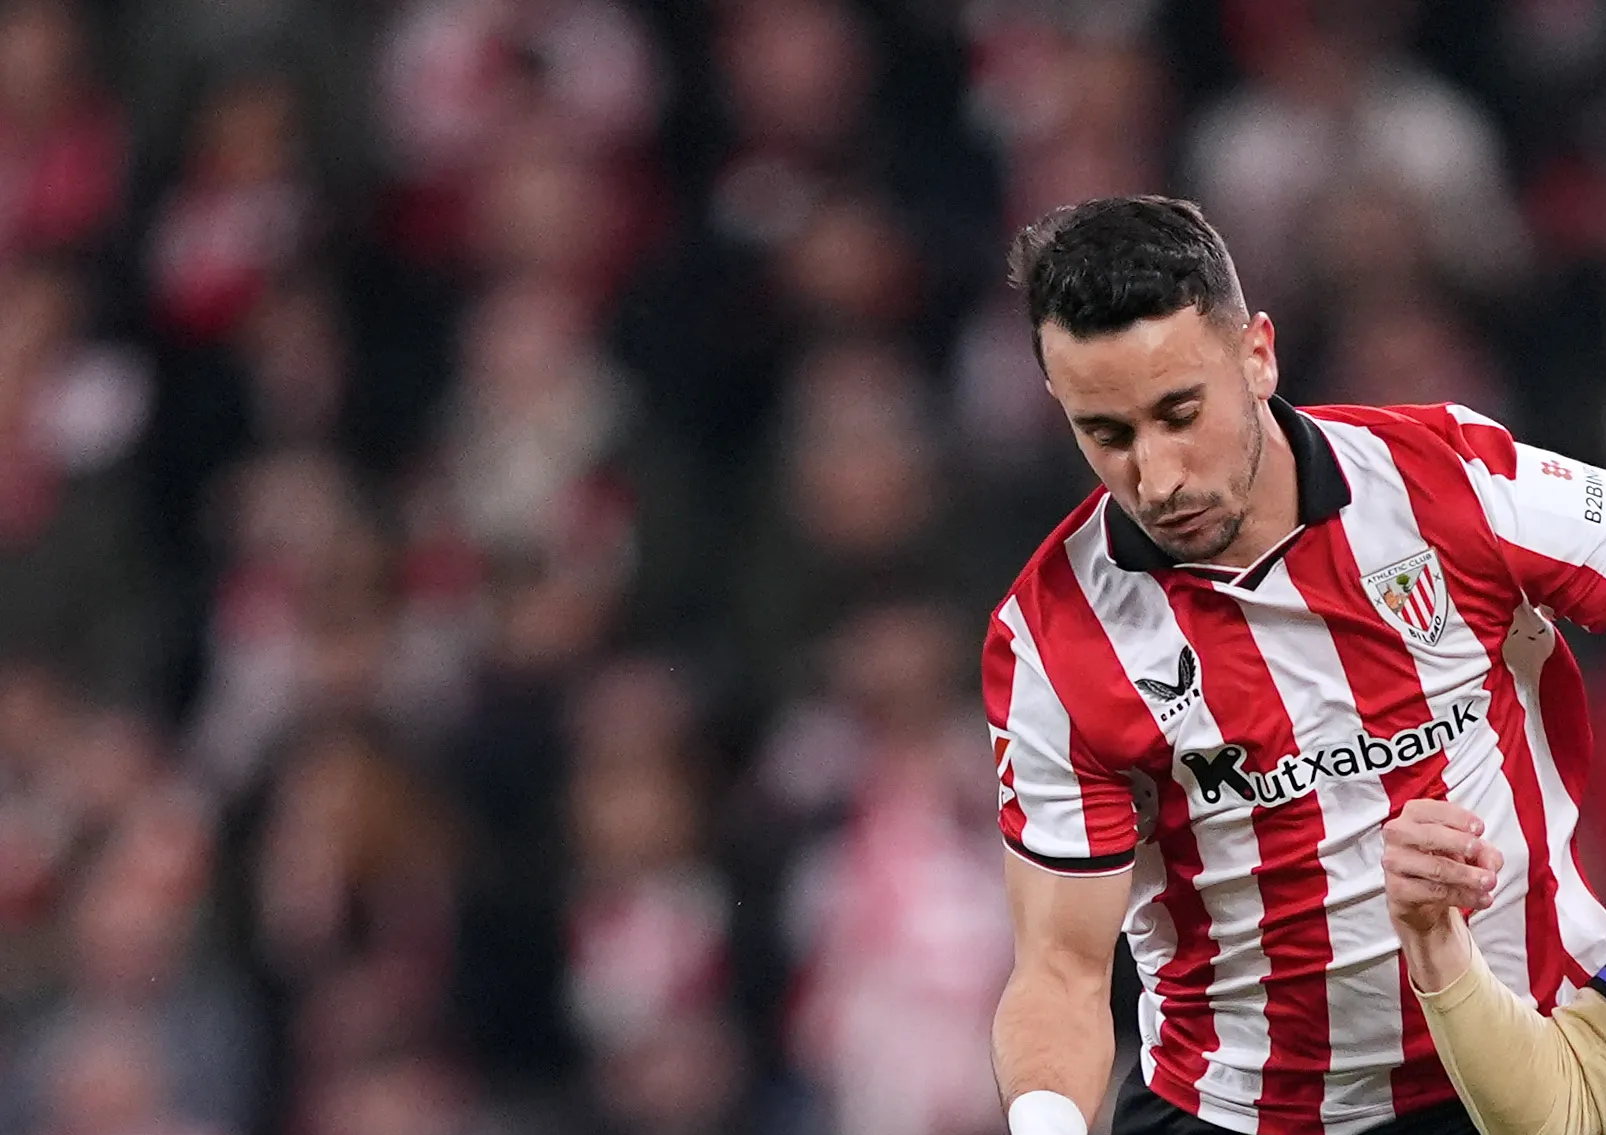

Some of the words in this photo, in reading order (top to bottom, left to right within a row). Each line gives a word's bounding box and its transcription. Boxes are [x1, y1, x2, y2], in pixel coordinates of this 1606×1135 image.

[1366, 562, 1408, 586] ATHLETIC
[1409, 552, 1433, 568] CLUB
[1408, 615, 1442, 644] BILBAO
[1180, 700, 1479, 804] Kutxabank
